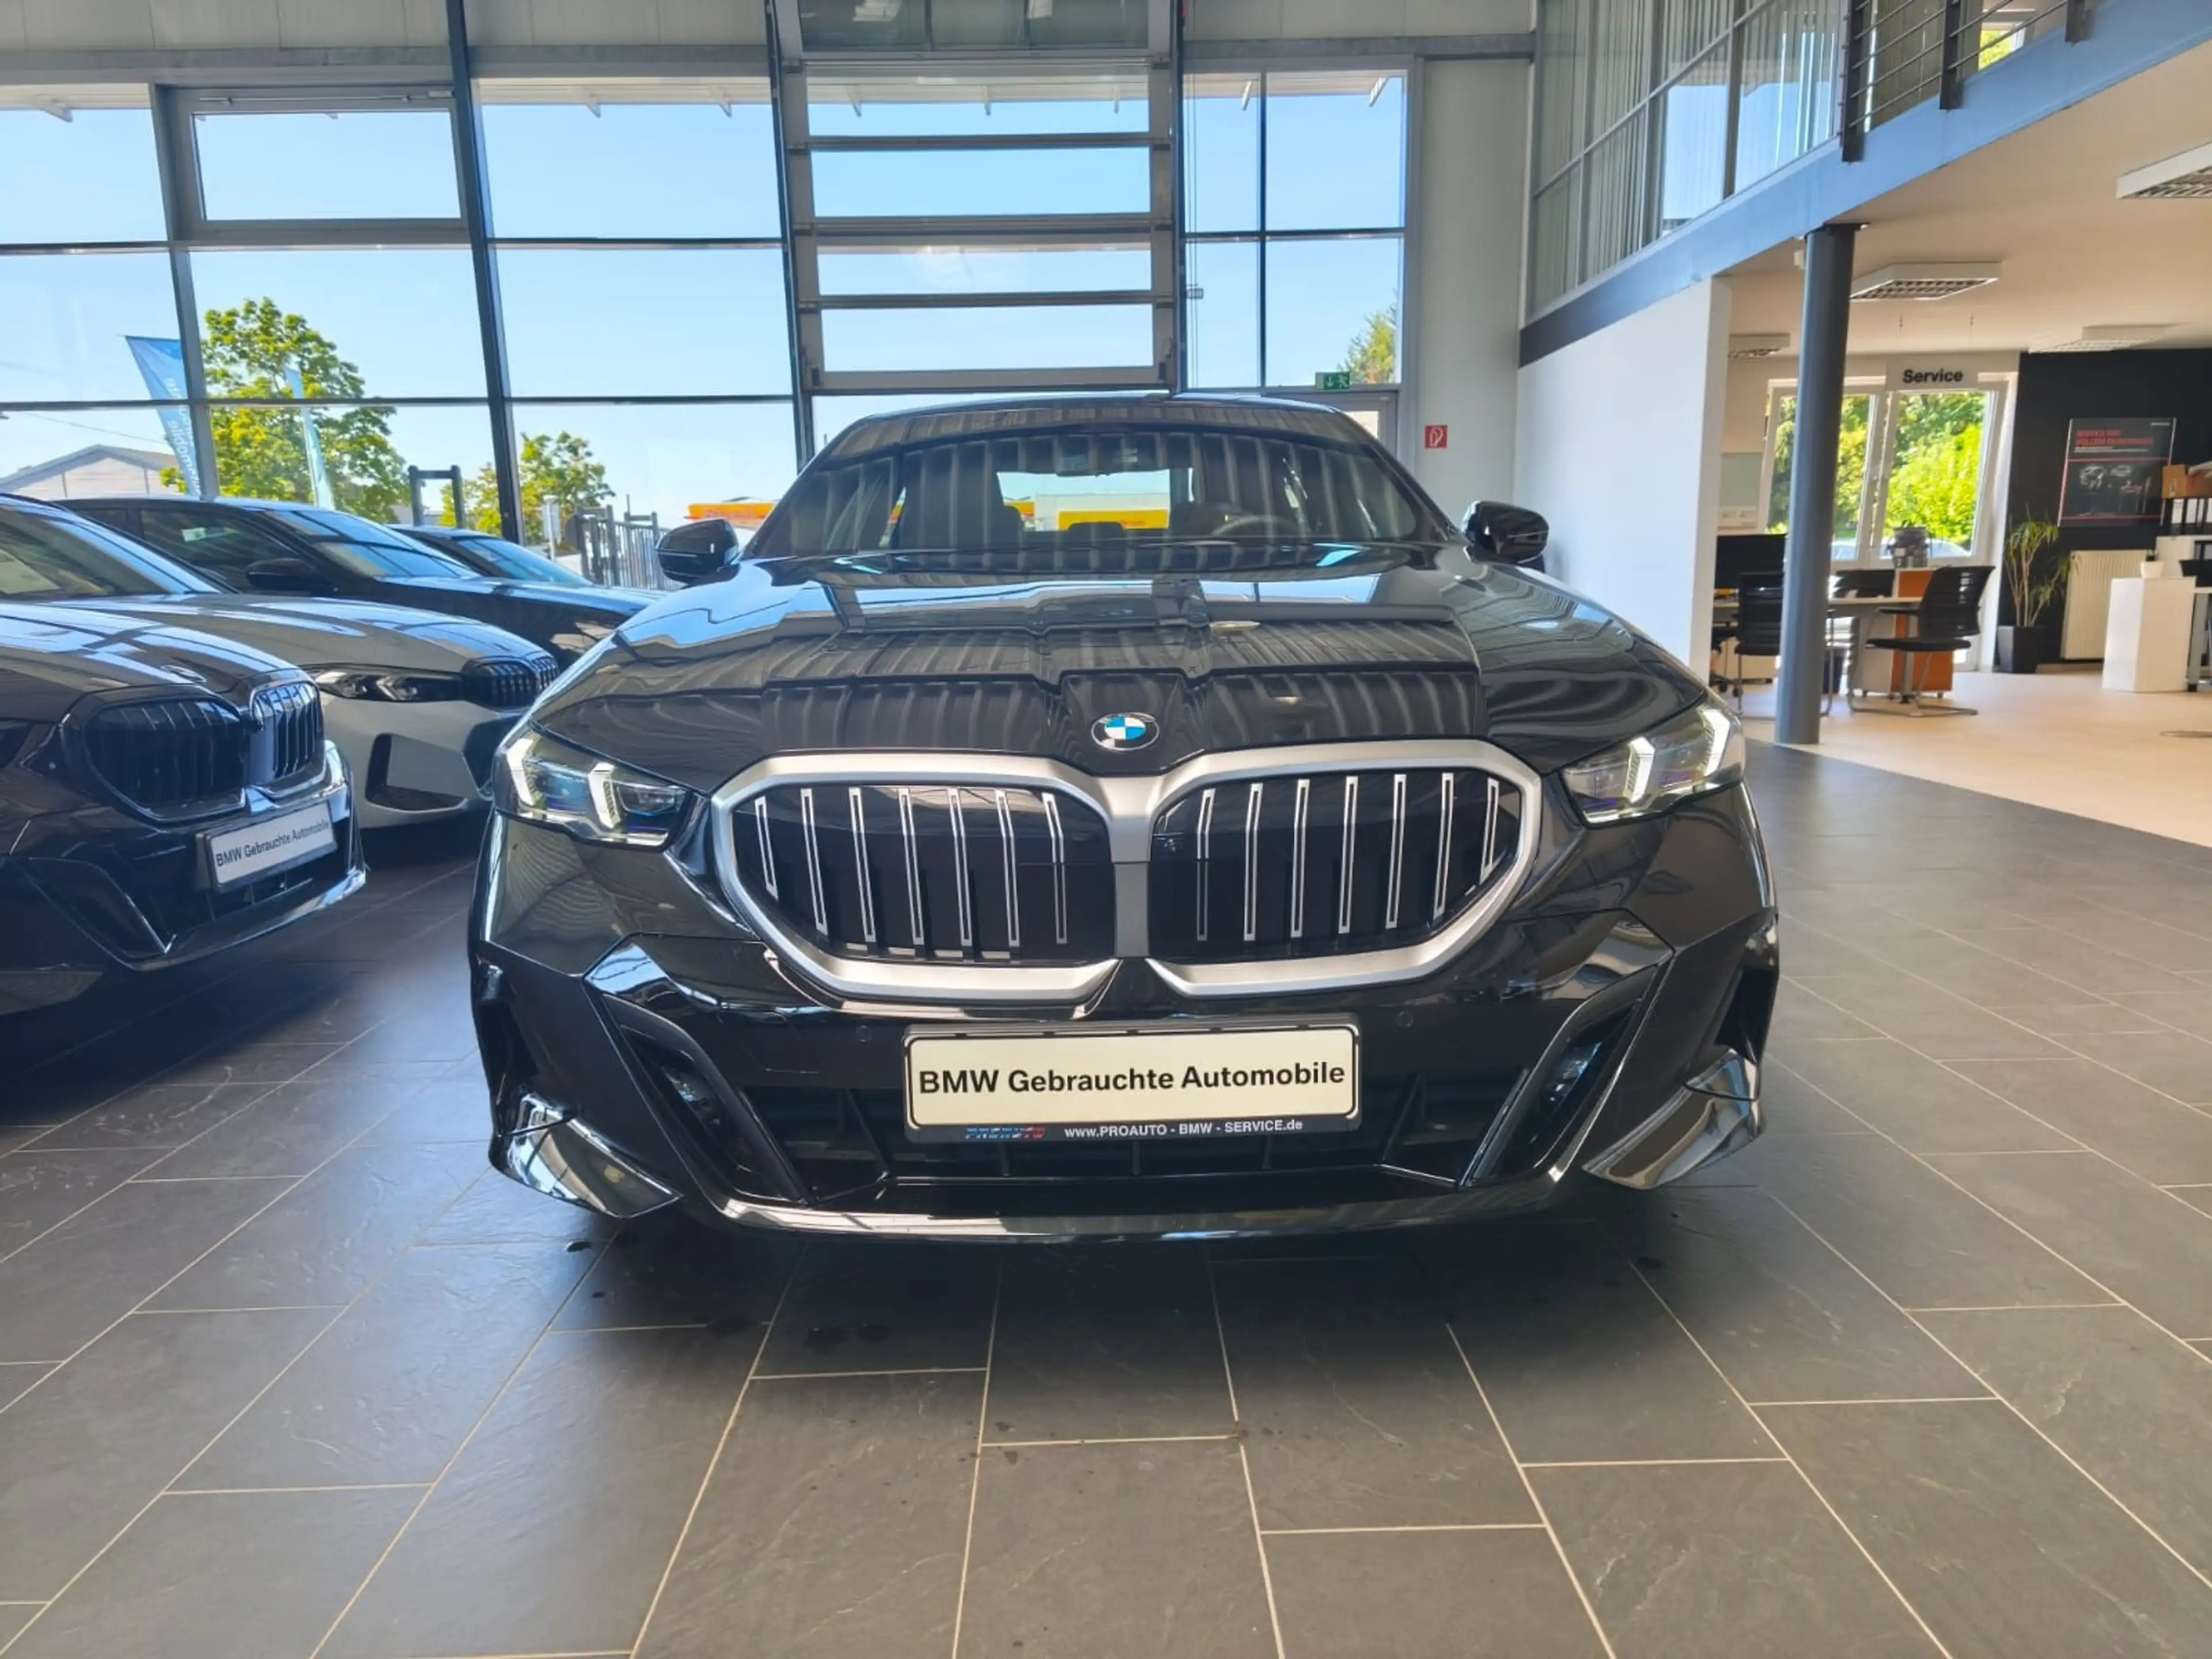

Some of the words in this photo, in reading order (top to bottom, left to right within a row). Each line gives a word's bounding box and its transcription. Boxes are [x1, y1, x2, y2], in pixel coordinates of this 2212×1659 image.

[1903, 368, 1964, 384] Service
[216, 846, 242, 867] BMW
[244, 832, 290, 858] Gebrauchte
[919, 1069, 999, 1093] BMW
[1008, 1067, 1174, 1092] Gebrauchte
[1181, 1062, 1345, 1088] Automobile
[1179, 1123, 1213, 1135] BMW
[1224, 1119, 1303, 1133] SERVICE.de
